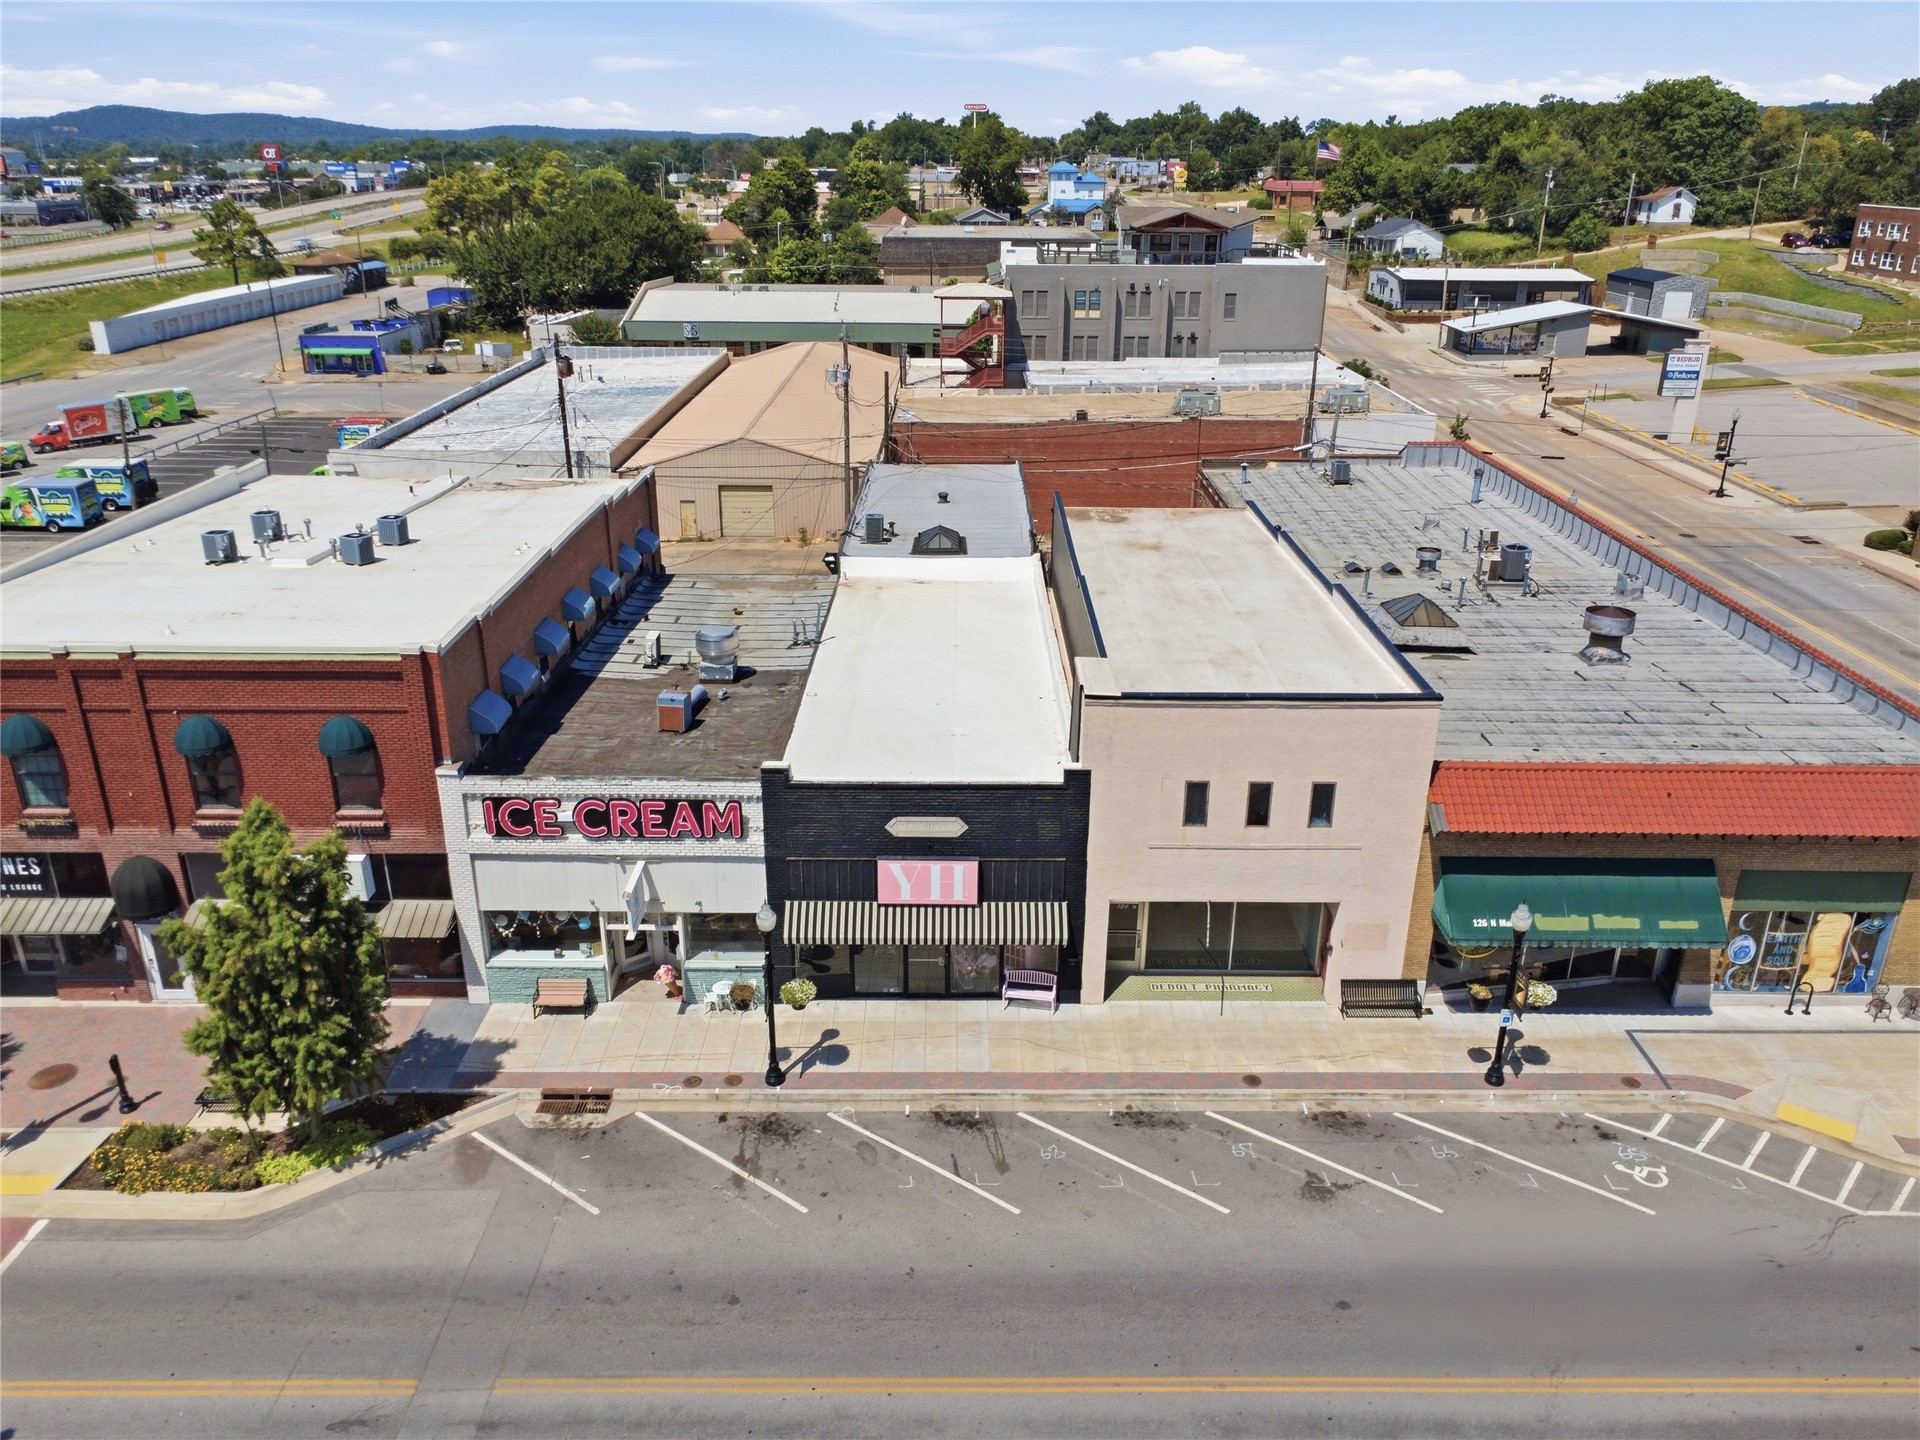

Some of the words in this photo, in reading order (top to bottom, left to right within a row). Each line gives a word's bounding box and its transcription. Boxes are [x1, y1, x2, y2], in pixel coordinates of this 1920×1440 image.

[263, 148, 276, 159] QT
[484, 799, 563, 837] ICE
[574, 799, 743, 838] CREAM
[887, 863, 969, 901] YH
[1472, 919, 1488, 927] 126
[1490, 919, 1497, 927] N
[1499, 919, 1513, 927] Mai
[1773, 945, 1793, 954] AND
[1766, 956, 1793, 965] SOUL
[1151, 983, 1197, 991] DEBOLT
